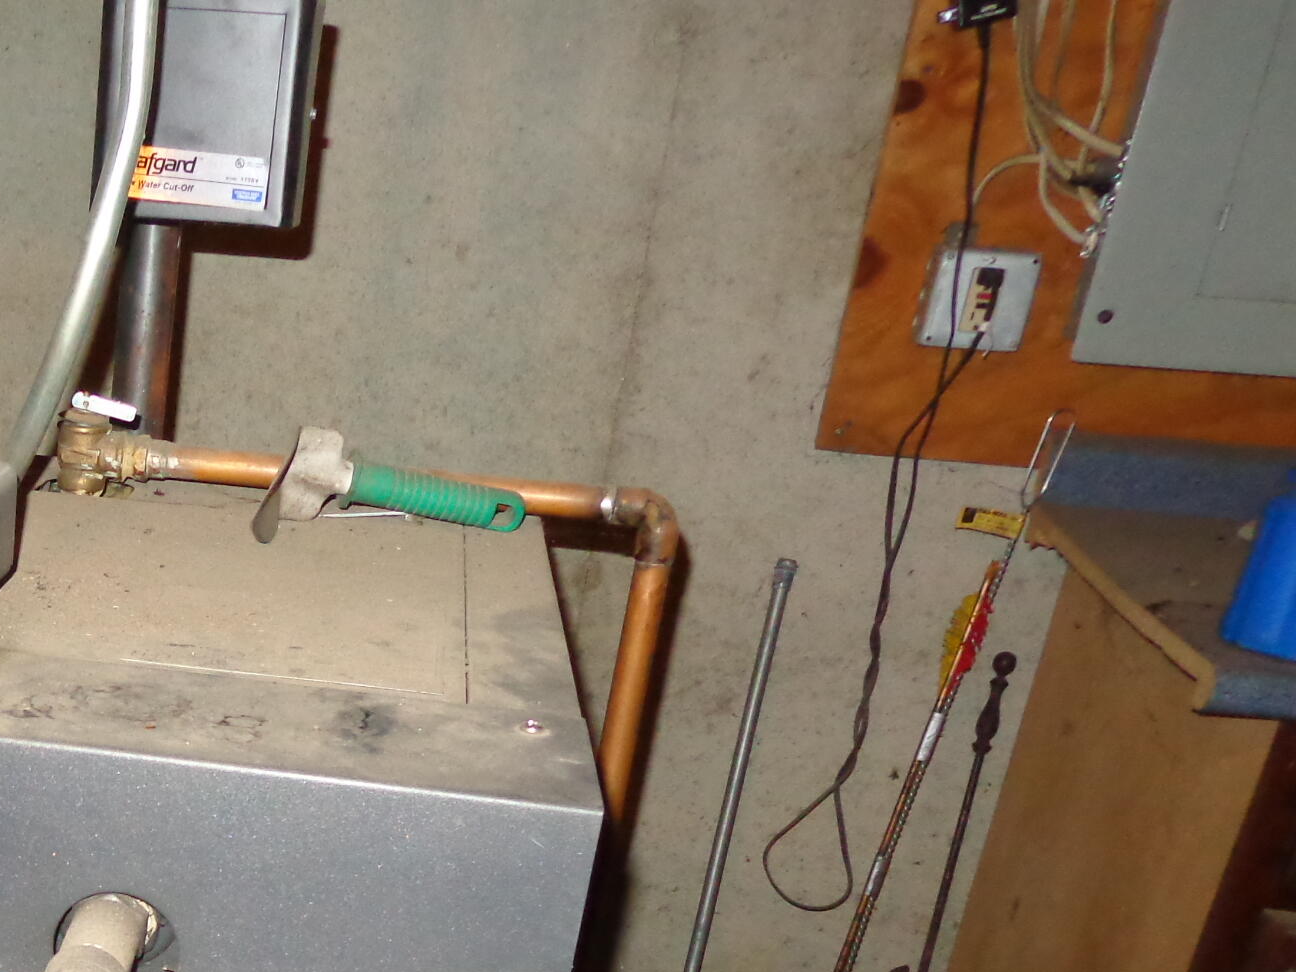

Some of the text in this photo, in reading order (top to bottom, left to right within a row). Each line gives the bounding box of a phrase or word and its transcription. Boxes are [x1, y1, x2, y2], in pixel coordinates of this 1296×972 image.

[136, 152, 198, 175] afgard
[138, 179, 195, 192] Water Cut-Off
